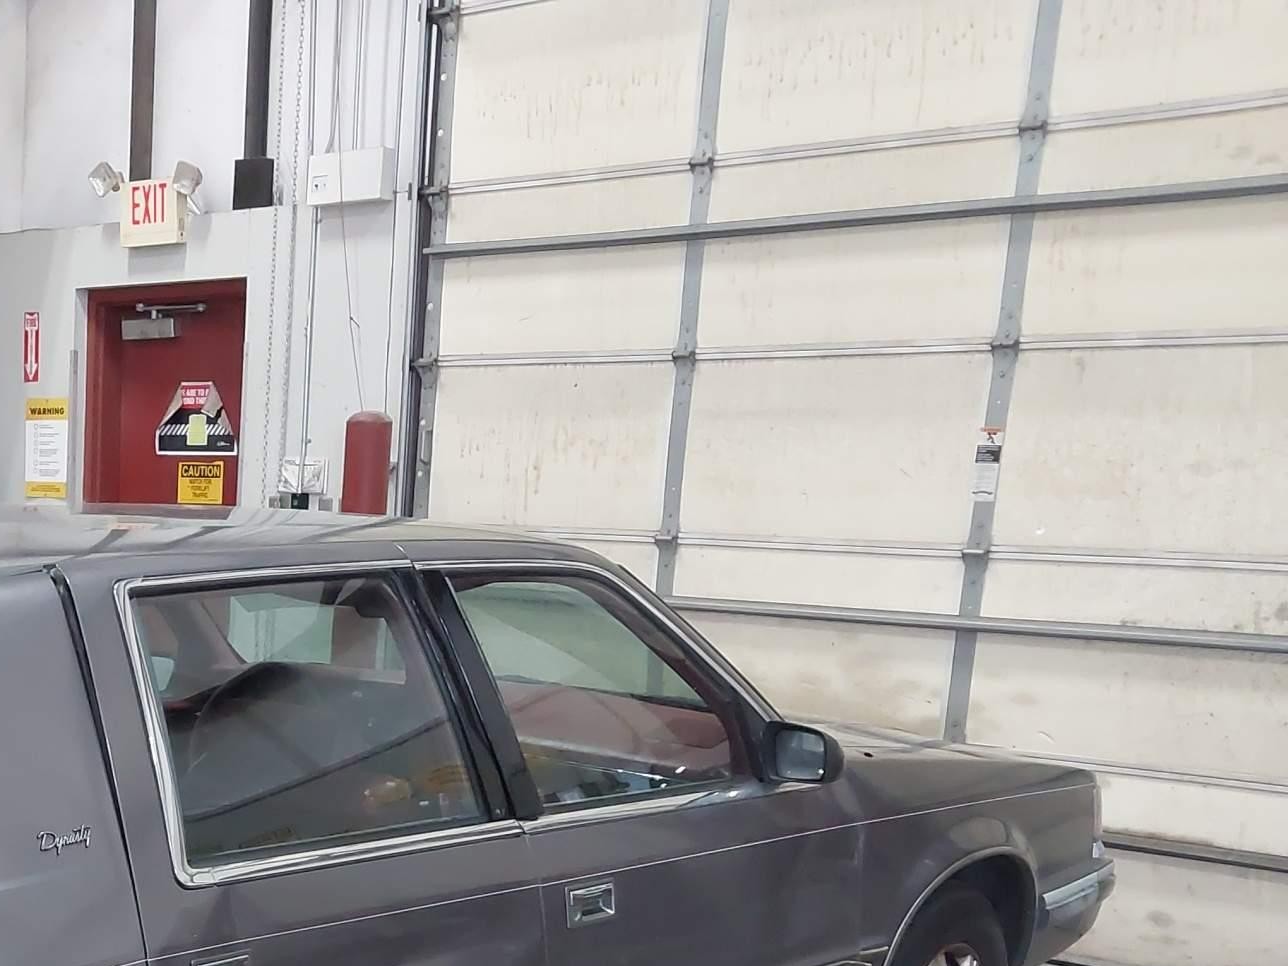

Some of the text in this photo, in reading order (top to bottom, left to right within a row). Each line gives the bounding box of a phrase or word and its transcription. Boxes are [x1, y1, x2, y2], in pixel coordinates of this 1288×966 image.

[132, 183, 167, 225] EXIT
[29, 407, 65, 416] WARNING
[182, 465, 220, 477] CAUTION
[37, 824, 91, 856] Dynasty
